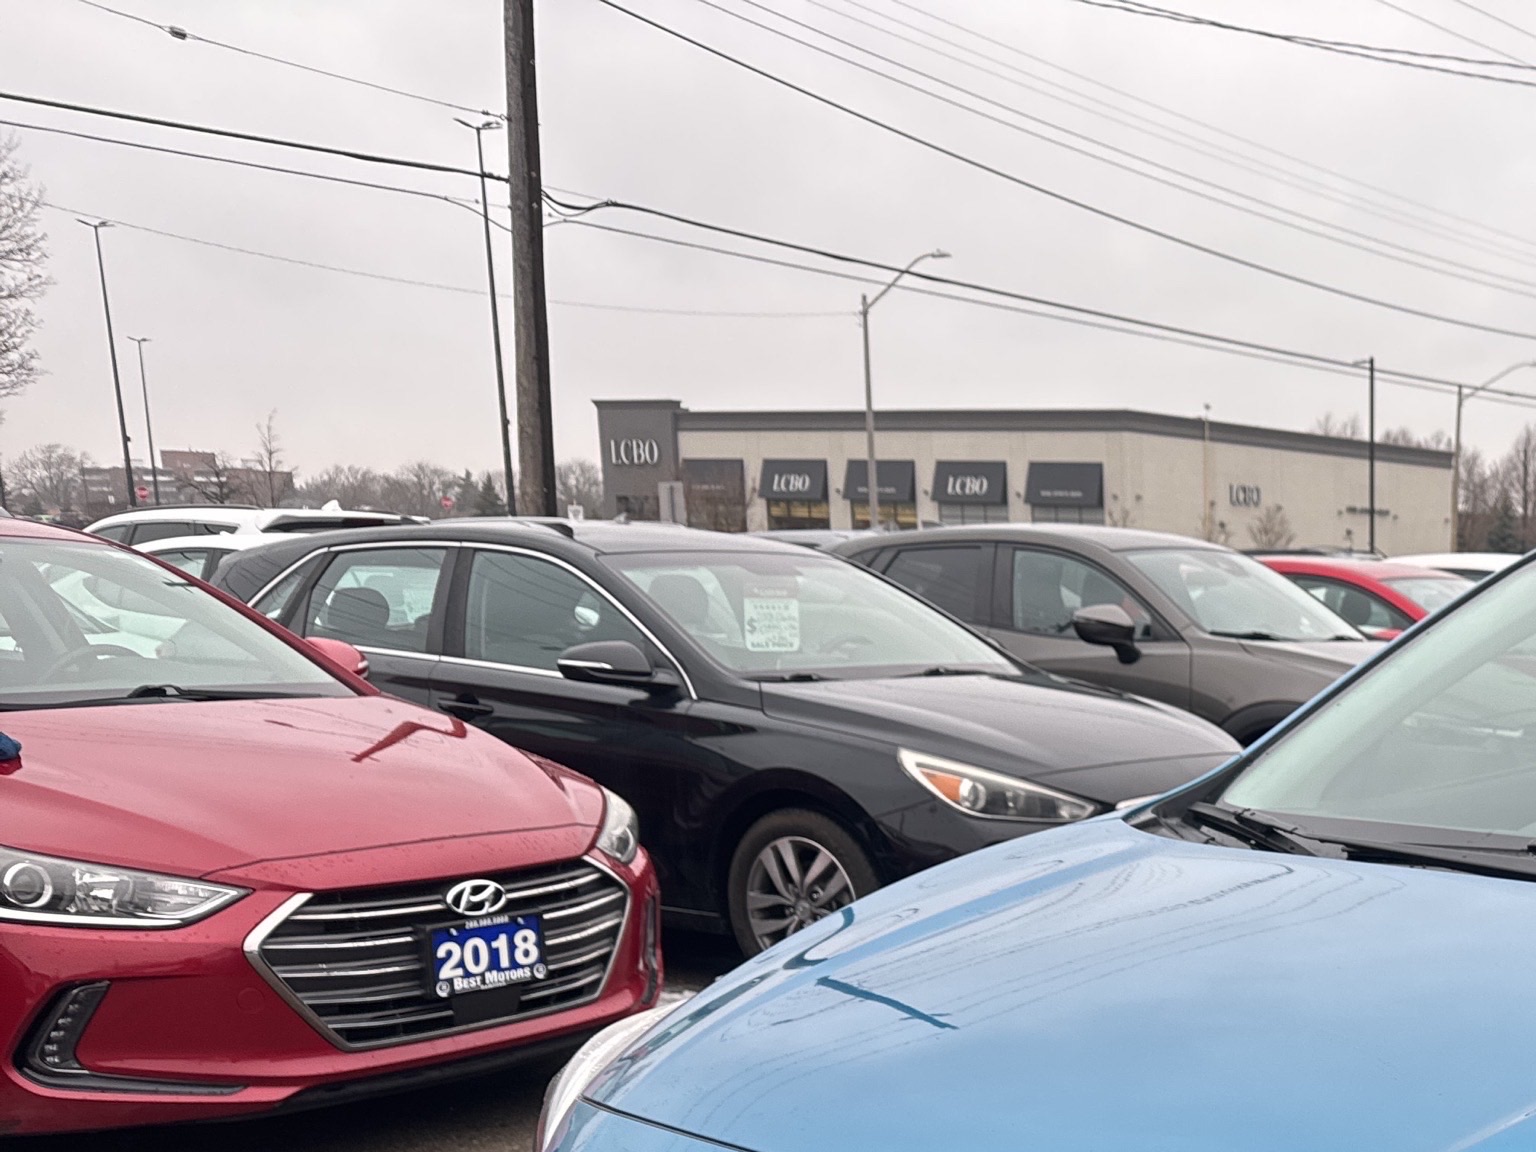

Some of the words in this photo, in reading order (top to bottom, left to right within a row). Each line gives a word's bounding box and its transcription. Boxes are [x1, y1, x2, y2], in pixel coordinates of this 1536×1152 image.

[610, 438, 659, 465] LCBO
[772, 473, 811, 492] LCBO
[947, 476, 988, 496] LCBO
[436, 928, 539, 980] 2018
[453, 975, 482, 990] BEST
[485, 966, 532, 985] MOTORS
